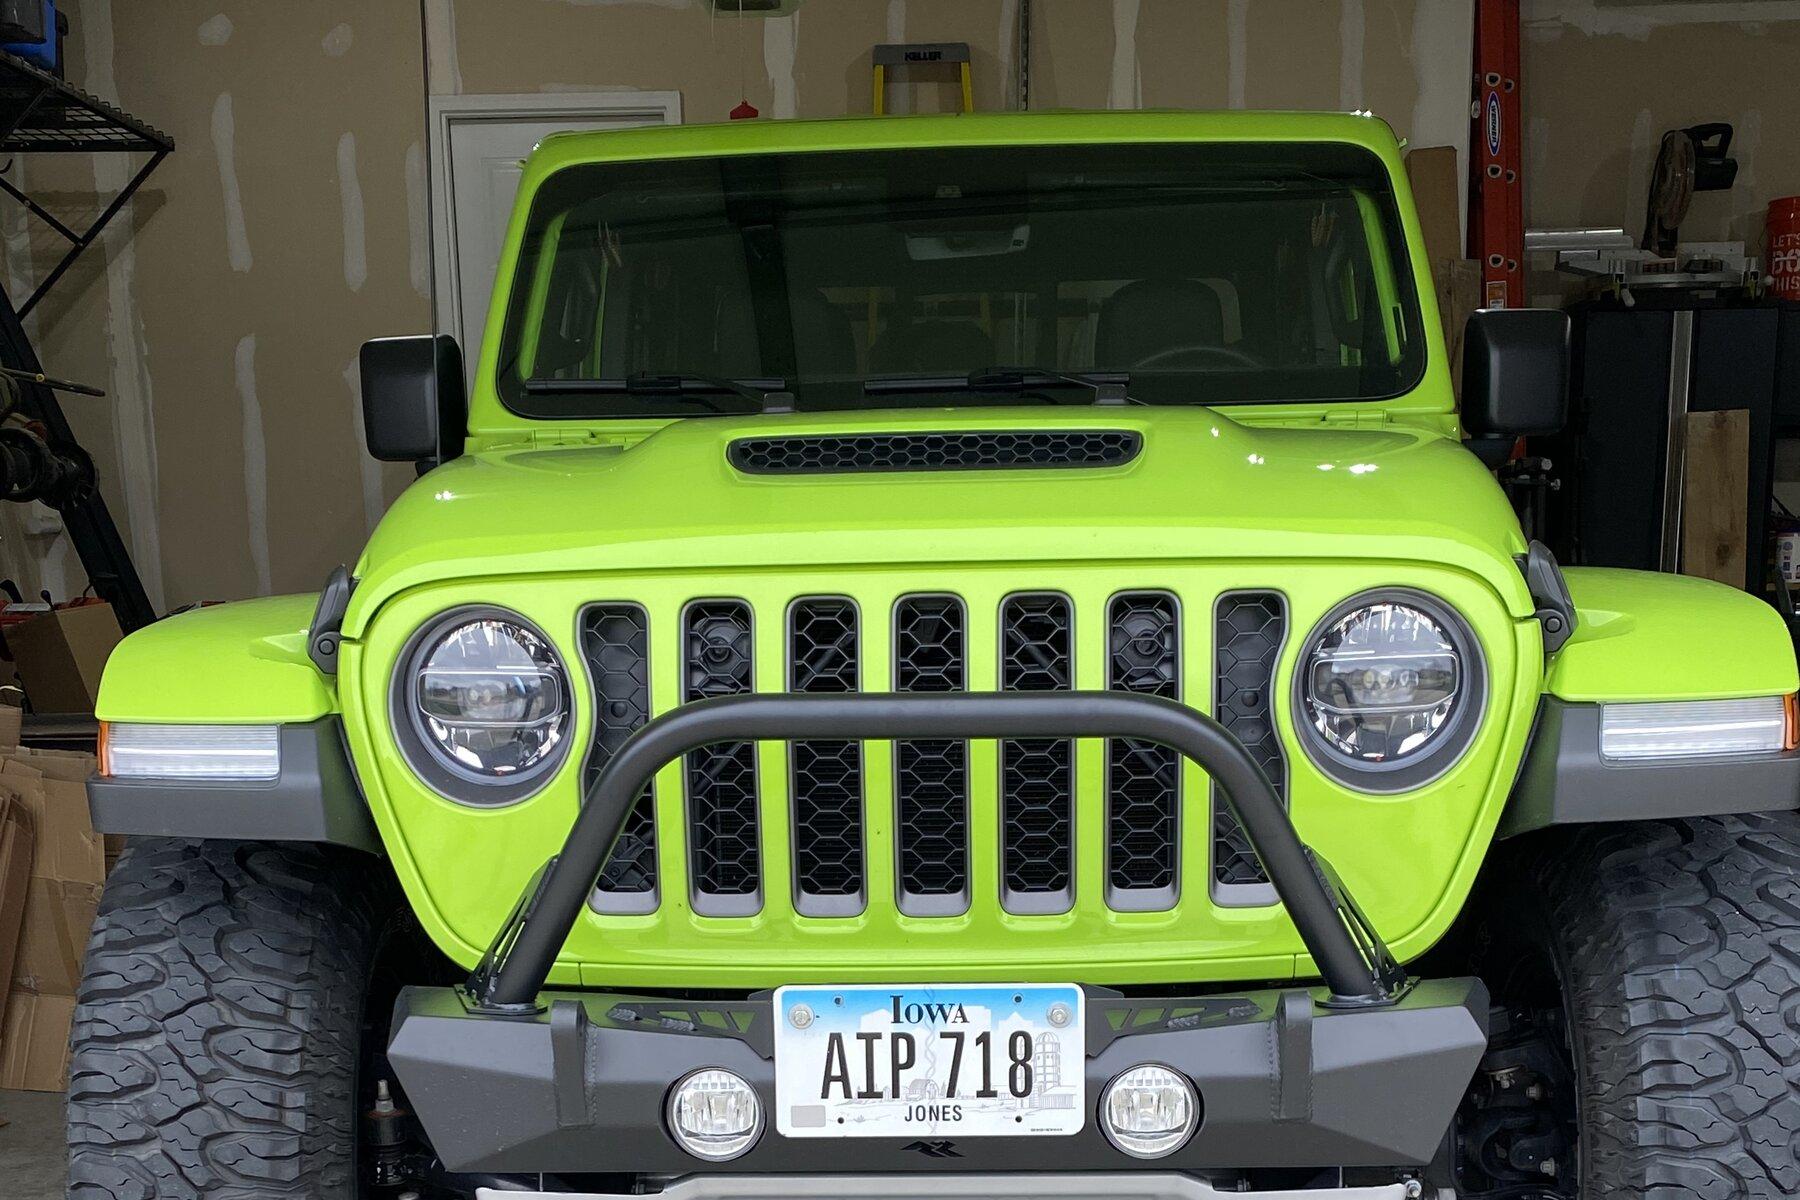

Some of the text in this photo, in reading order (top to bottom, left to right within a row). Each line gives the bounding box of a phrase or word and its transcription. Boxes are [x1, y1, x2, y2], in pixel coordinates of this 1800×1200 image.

[905, 51, 941, 61] KELLER
[821, 1030, 1033, 1099] AIP 718
[904, 1105, 963, 1122] JONES
